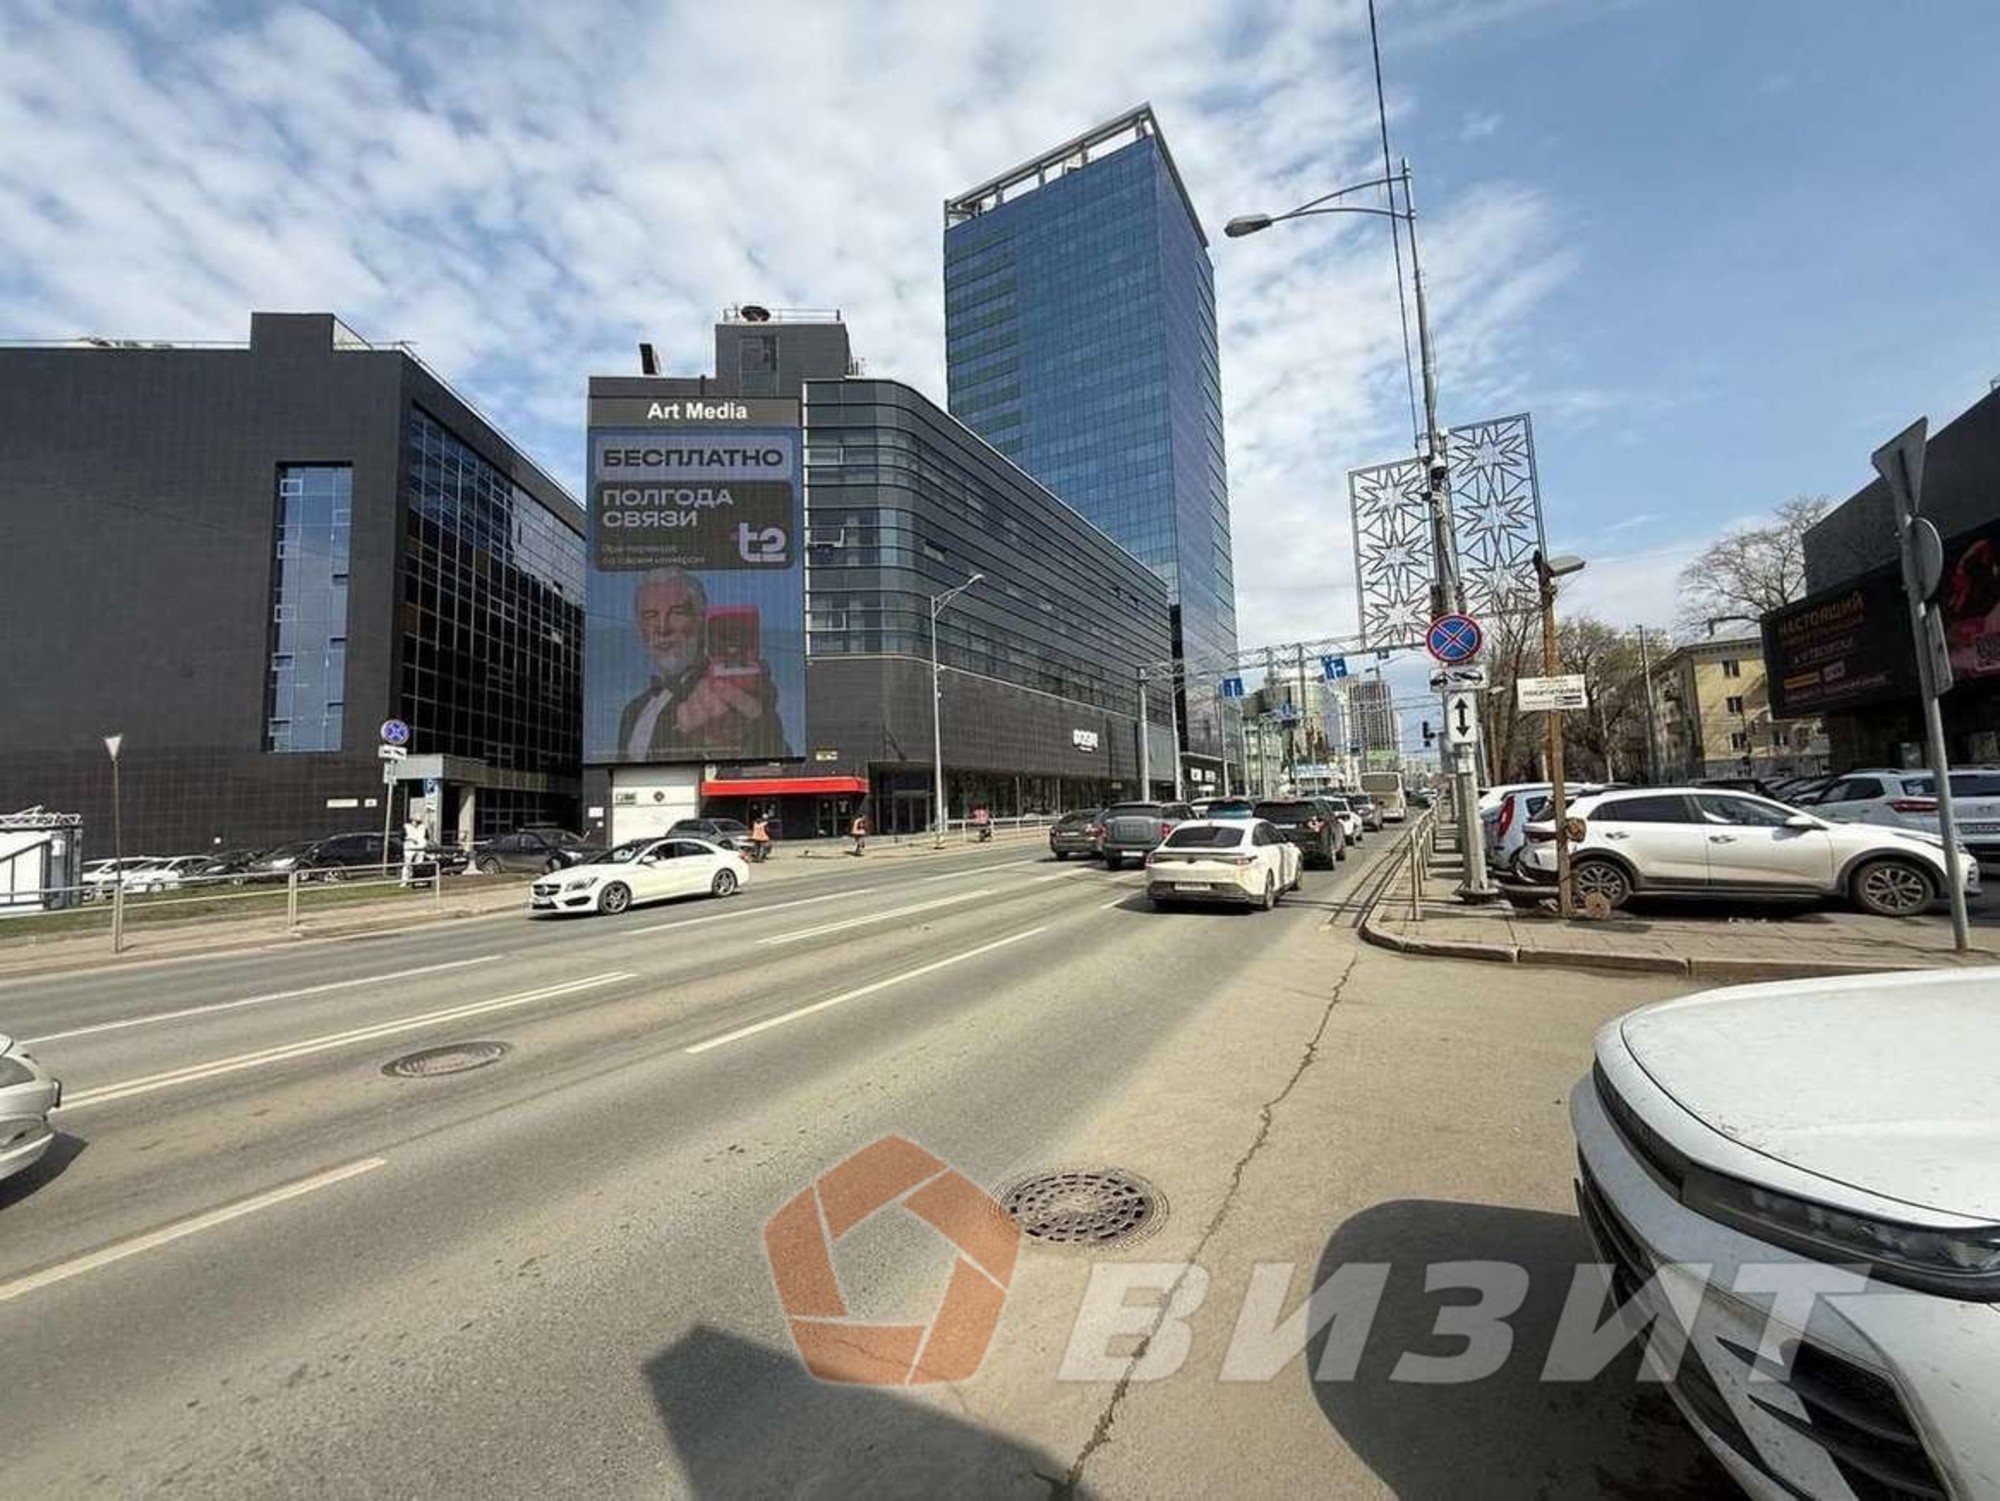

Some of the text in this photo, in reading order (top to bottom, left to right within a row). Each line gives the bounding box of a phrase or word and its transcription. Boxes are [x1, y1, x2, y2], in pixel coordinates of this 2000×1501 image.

[647, 402, 748, 419] Art Media
[603, 449, 783, 467] БЕСПЛАТНО
[603, 488, 734, 508] ПОЛГОДА
[603, 511, 698, 528] СВЯЗИ
[738, 522, 787, 562] t2
